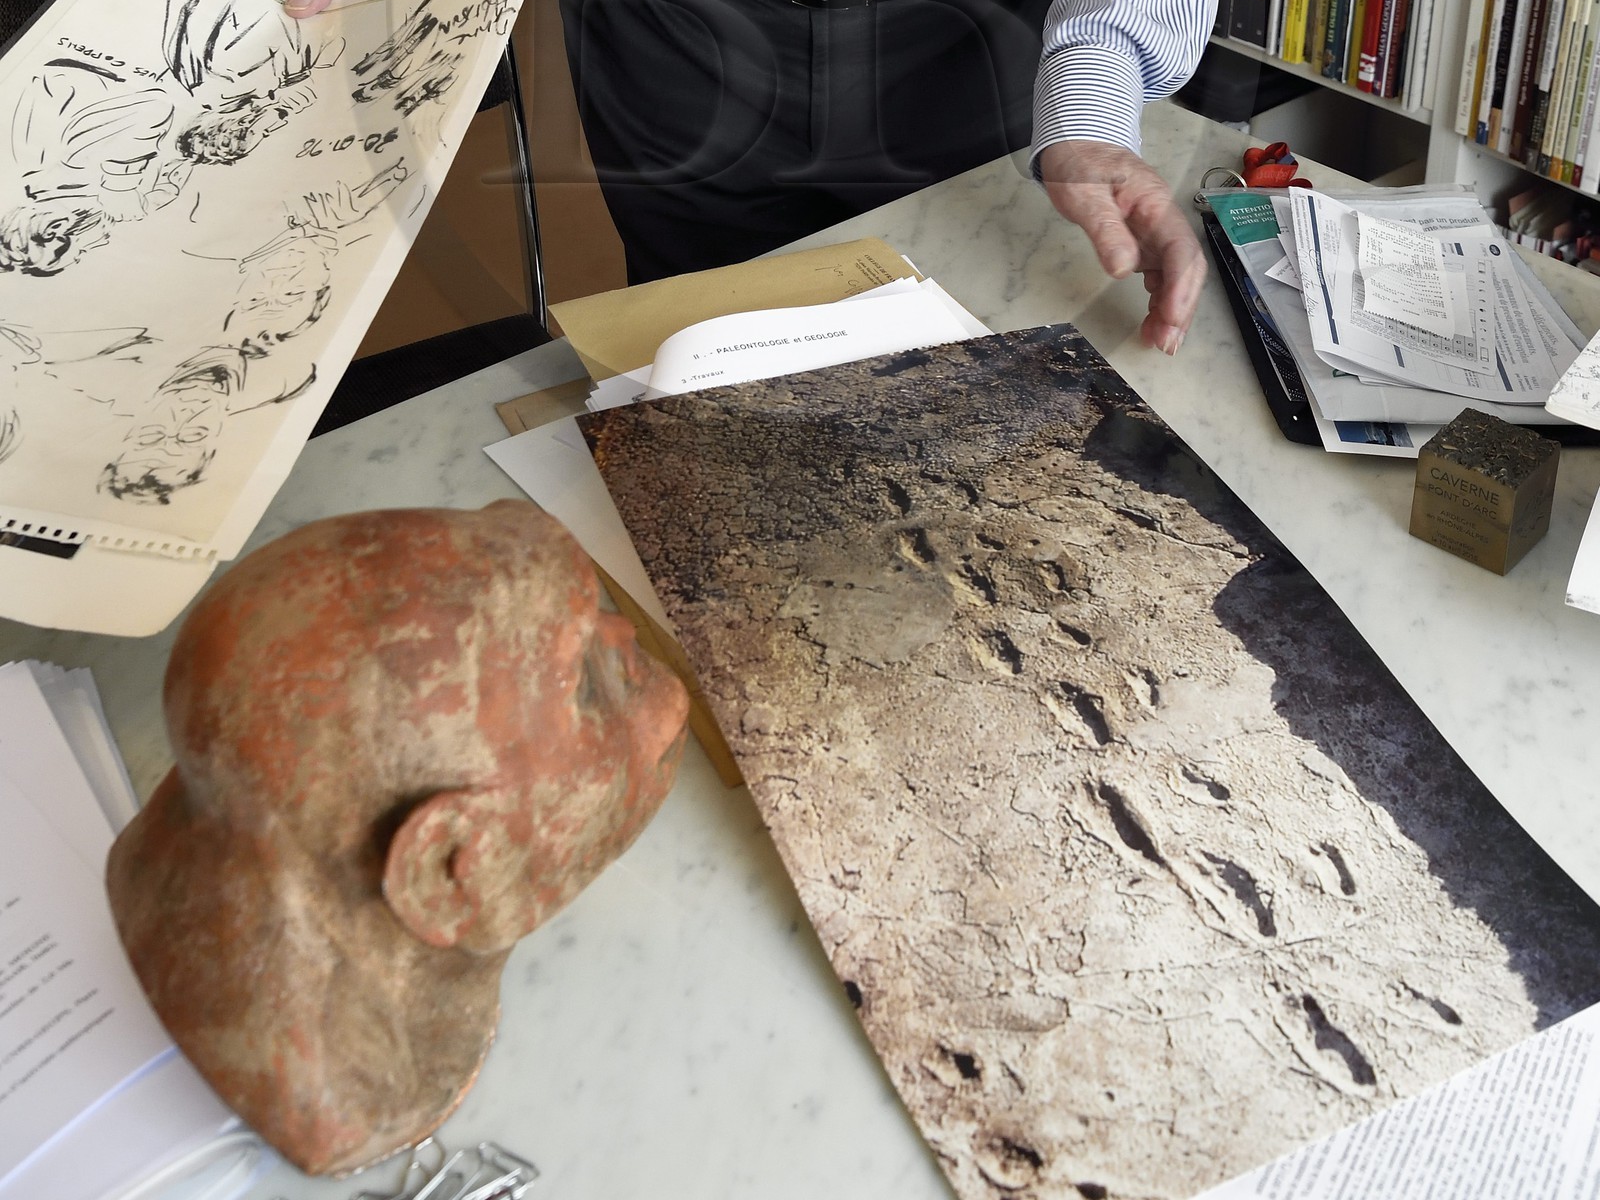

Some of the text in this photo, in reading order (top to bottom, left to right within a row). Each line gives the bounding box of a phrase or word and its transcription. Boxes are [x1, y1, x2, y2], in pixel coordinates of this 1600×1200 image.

[1327, 29, 1335, 43] LES
[1378, 32, 1387, 58] ATLAS
[1229, 203, 1274, 215] ATTENTIO
[1254, 210, 1275, 218] ferm
[1236, 218, 1260, 227] cette
[1418, 216, 1480, 226] pas un produit
[1501, 278, 1521, 310] ordonnance
[716, 337, 791, 355] PALEONTOLOGIE
[804, 329, 849, 342] GEOLOGIE
[1430, 467, 1500, 506] CAVERNE
[1427, 483, 1497, 520] PONT D'ARC
